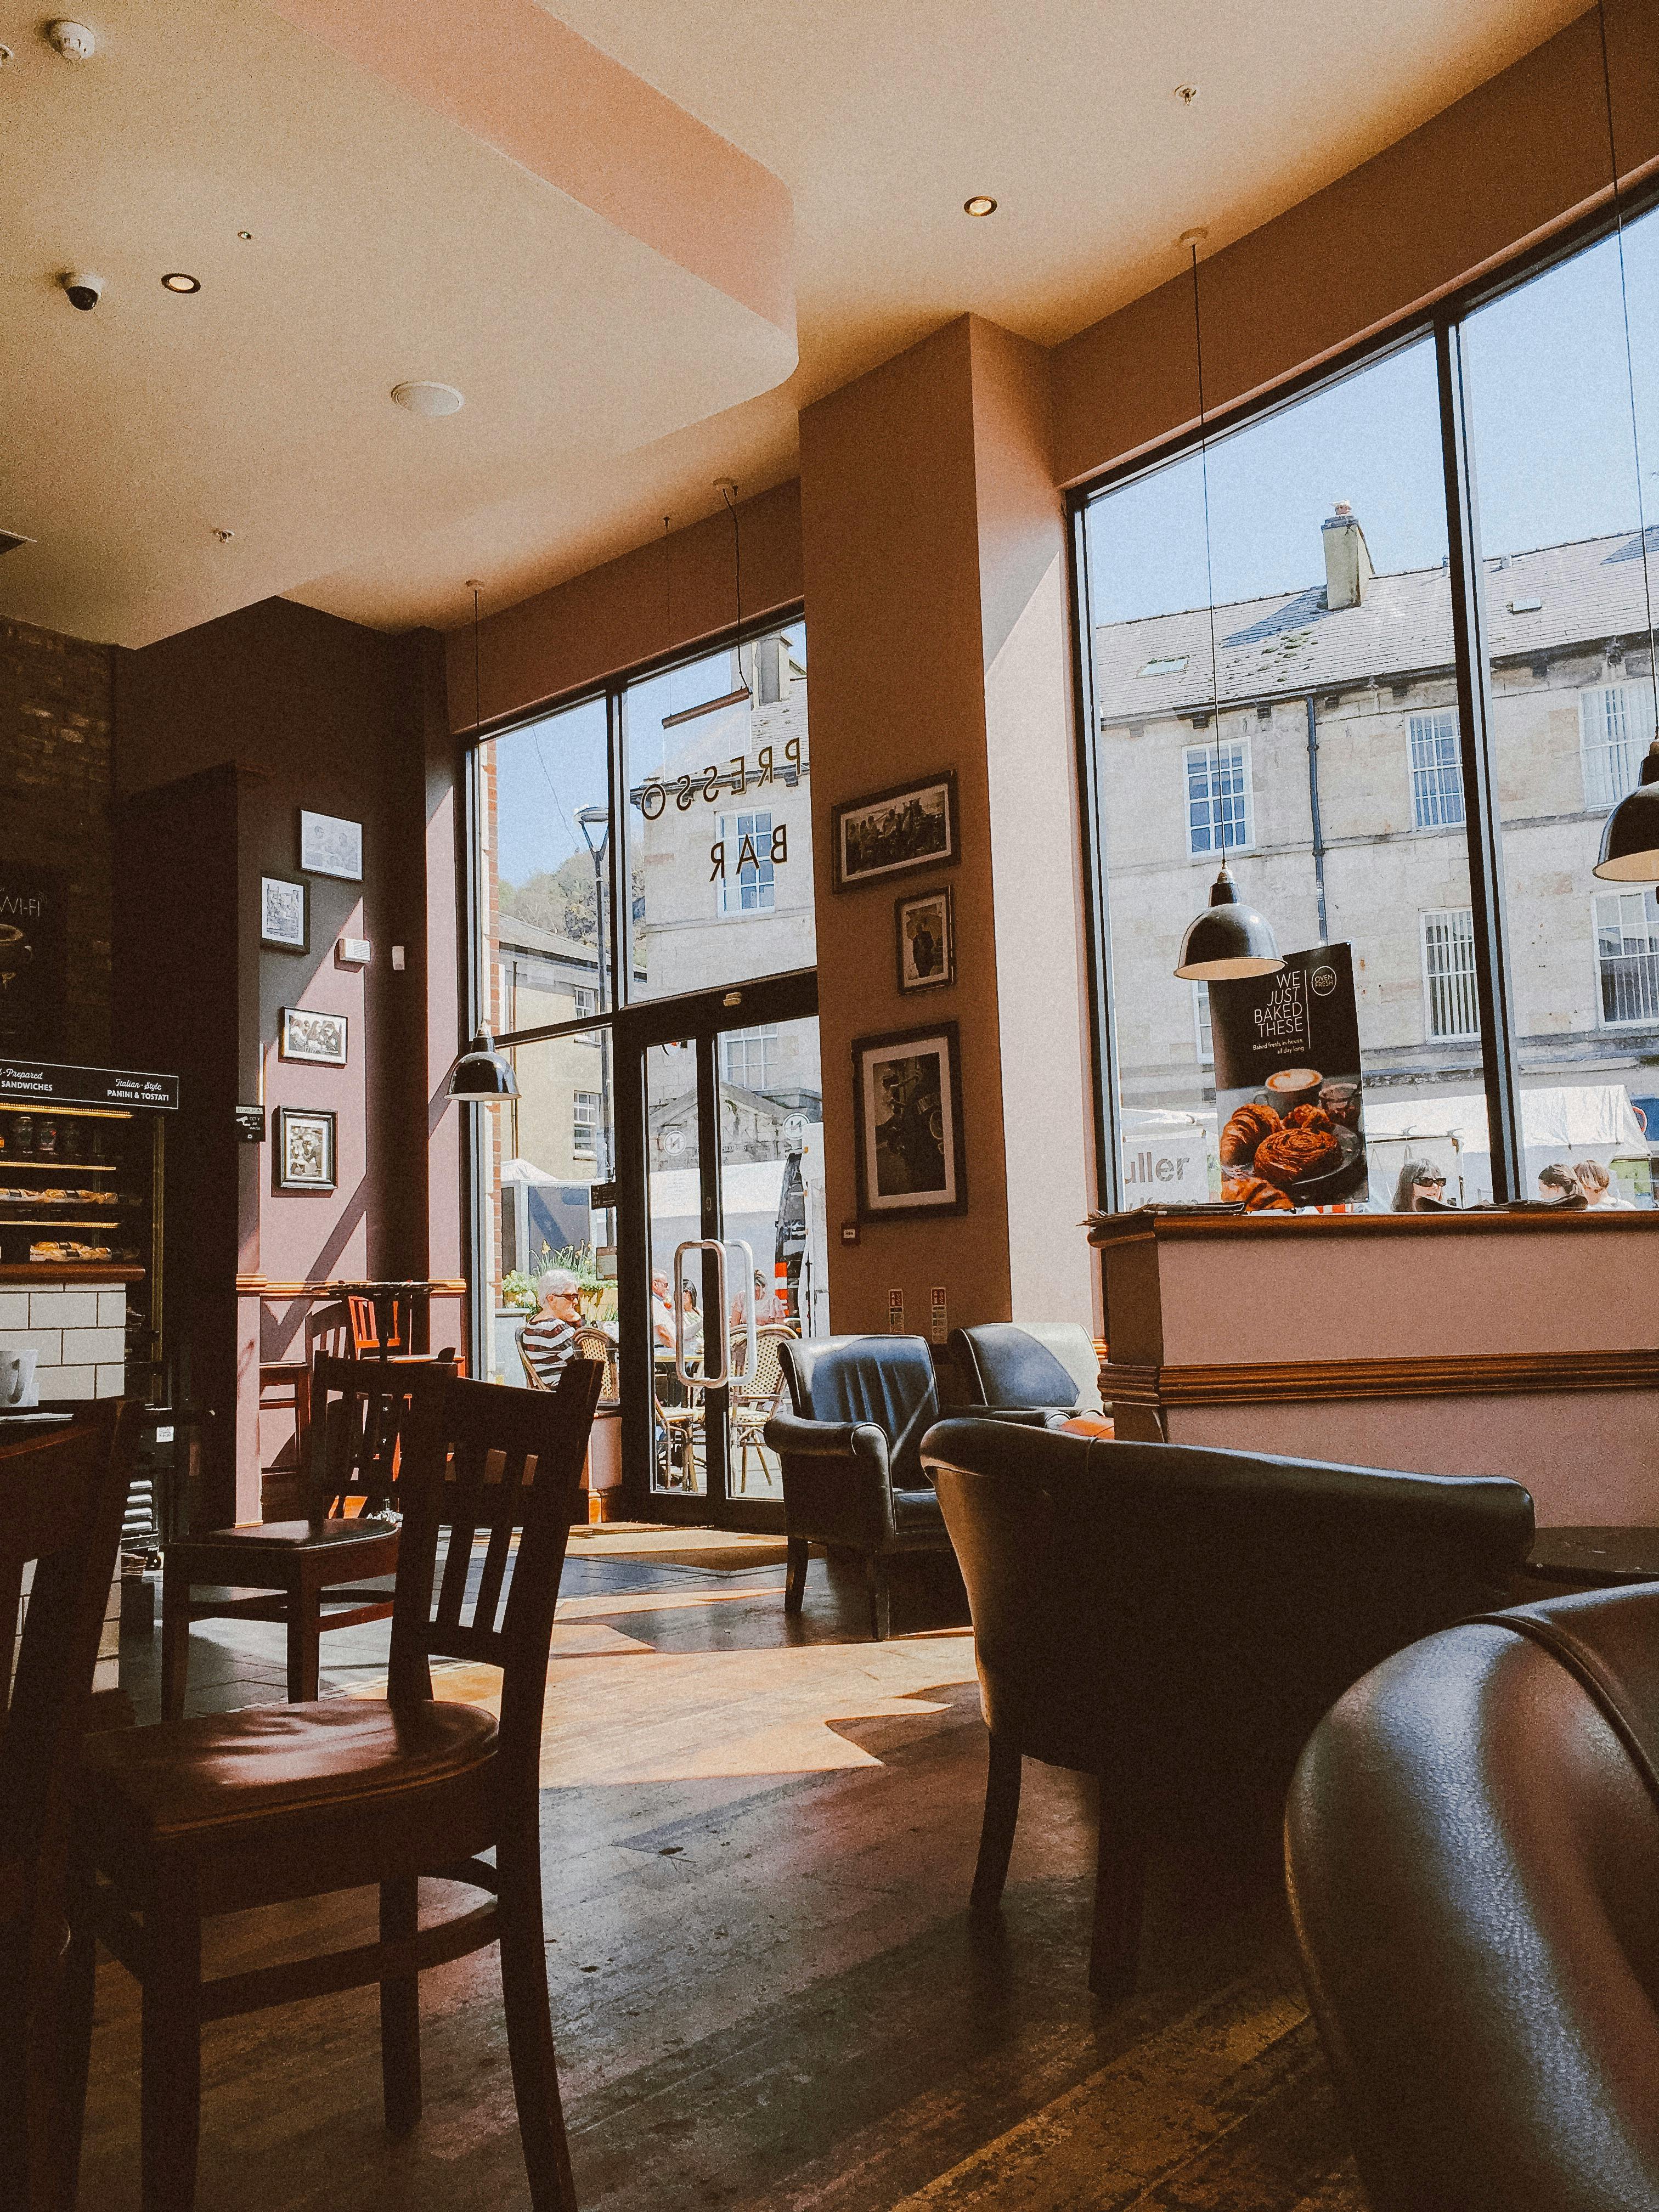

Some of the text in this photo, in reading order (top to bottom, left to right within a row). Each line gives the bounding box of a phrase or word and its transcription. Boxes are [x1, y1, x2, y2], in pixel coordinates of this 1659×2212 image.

[1276, 970, 1301, 988] WE
[1314, 974, 1333, 983] OVEN
[1315, 979, 1333, 988] FRESH
[1267, 986, 1301, 1006] JUST
[1254, 1002, 1302, 1024] BAKED
[1257, 1017, 1304, 1037] THESE
[1, 1080, 53, 1092] SANDWICHES
[107, 1090, 133, 1099] PANINI
[141, 1093, 169, 1102] TOSTATI
